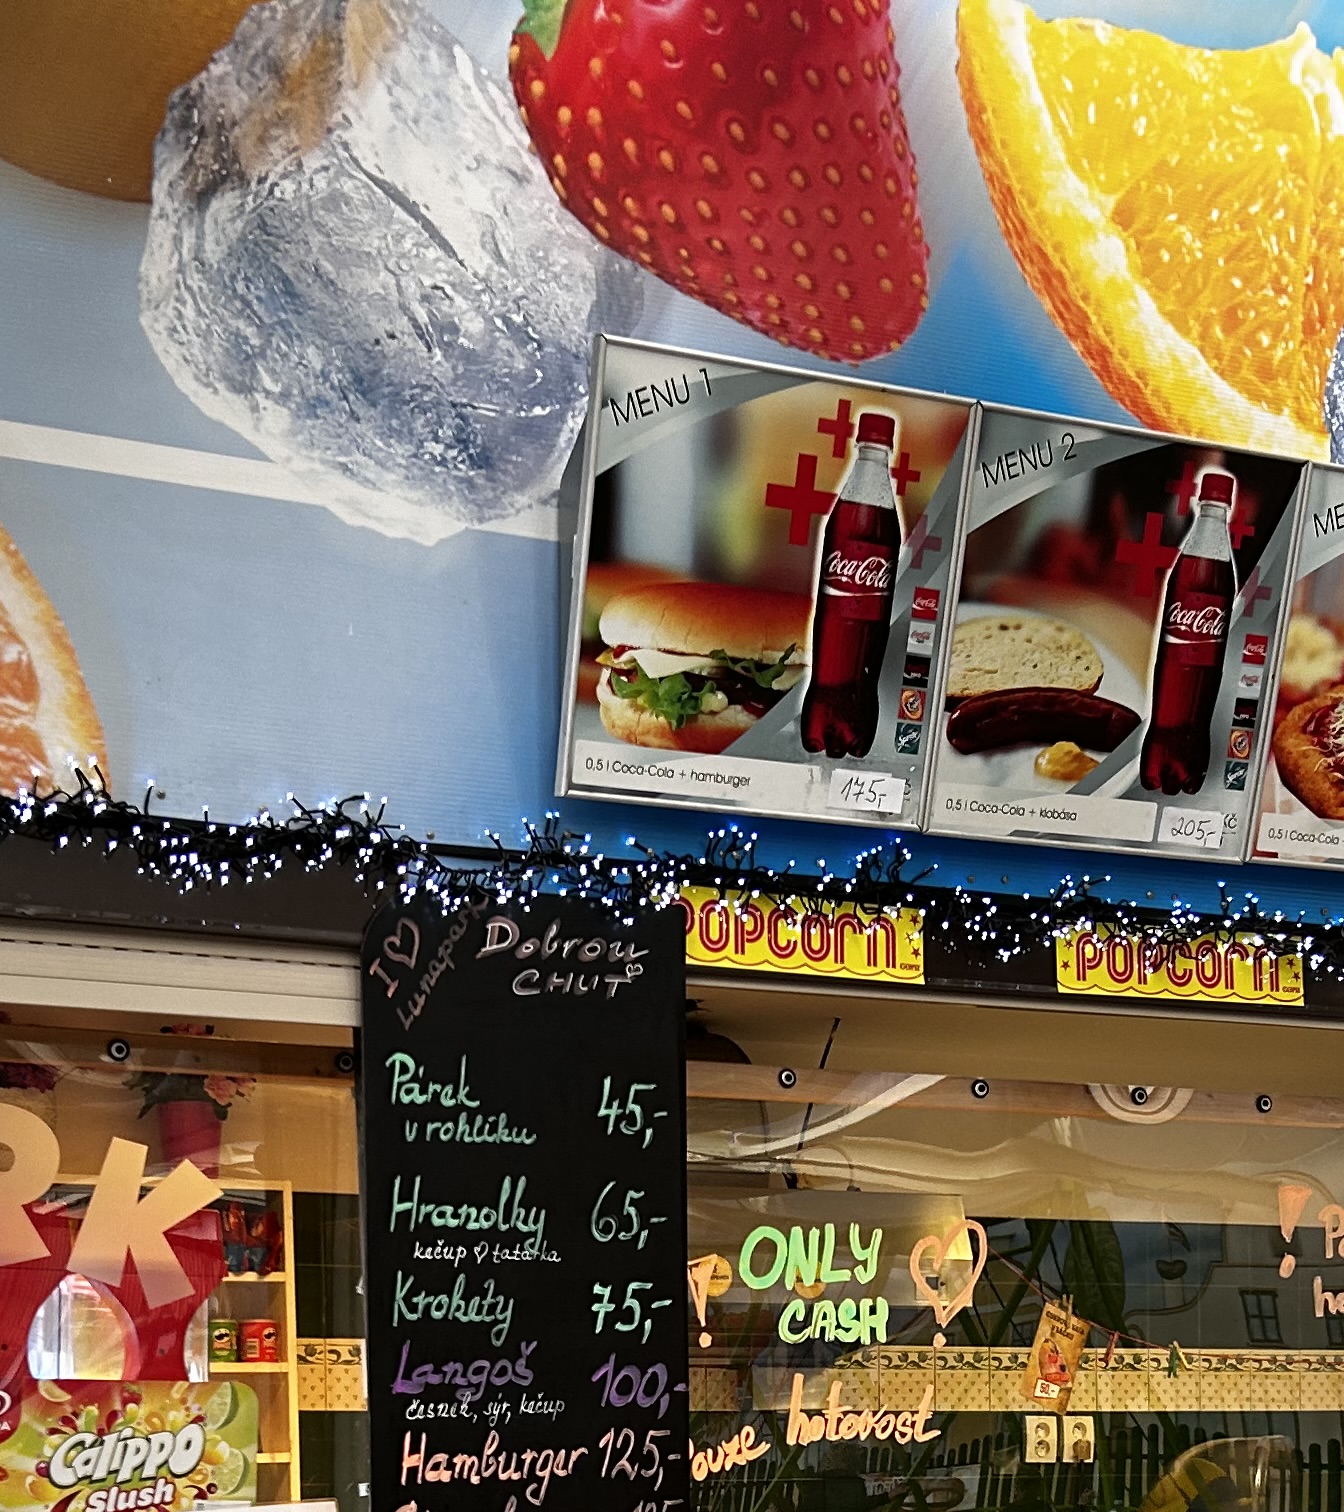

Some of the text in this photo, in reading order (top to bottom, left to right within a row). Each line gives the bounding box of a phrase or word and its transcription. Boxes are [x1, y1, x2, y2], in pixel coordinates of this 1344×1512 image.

[608, 368, 712, 426] MENU 1
[980, 433, 1078, 488] MENU 2
[612, 760, 751, 788] Coca-Cola hamburger
[1039, 806, 1077, 822] klobása
[385, 1052, 668, 1149] Párek 45,-
[427, 1112, 537, 1144] rohlíku
[390, 1175, 667, 1252] Hranolky 65,-
[738, 1222, 883, 1289] ONLY
[393, 1271, 672, 1347] Krokety 75,-
[779, 1296, 889, 1345] CASH
[391, 1340, 538, 1399] Langoš
[48, 1423, 206, 1487] Calippo
[401, 1428, 681, 1506] Hamburger 125,-
